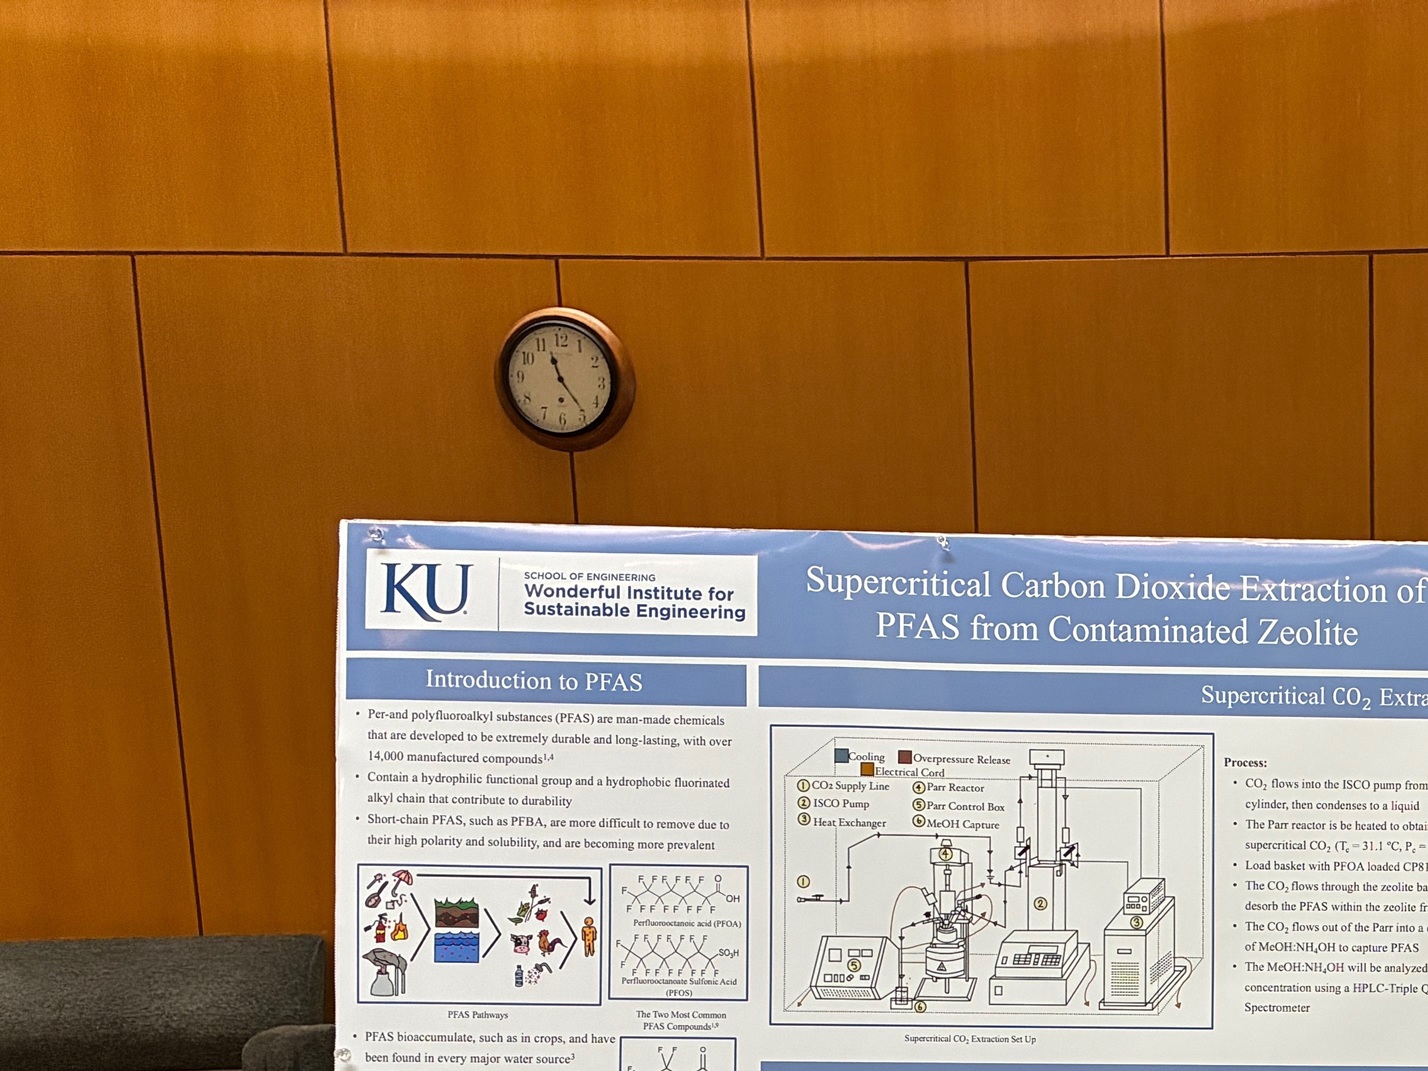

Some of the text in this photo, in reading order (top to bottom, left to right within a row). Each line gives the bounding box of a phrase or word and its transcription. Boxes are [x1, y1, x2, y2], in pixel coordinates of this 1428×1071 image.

[536, 338, 545, 351] 11
[555, 333, 568, 347] 12
[577, 339, 582, 353] 1
[522, 352, 534, 365] 10
[591, 356, 599, 368] 2
[517, 371, 524, 383] 9
[598, 377, 605, 390] 3
[524, 393, 531, 404] 8
[593, 395, 599, 408] 4
[541, 407, 548, 420] 7
[559, 412, 566, 426] 6
[579, 409, 586, 422] 5
[523, 571, 656, 582] SCHOOL OF ENGINEERING
[806, 564, 991, 600] Supercritical
[1001, 570, 1106, 599] Carbon
[1114, 572, 1231, 602] Dioxide
[1238, 574, 1388, 604] Extraction
[380, 563, 474, 622] KU
[523, 582, 734, 601] Wonderful Institute for
[523, 600, 745, 622] Sustainable Engineering
[875, 611, 1358, 646] PFAS from Contaminated Zeolite
[426, 668, 642, 692] Introduction to PFAS
[1201, 684, 1325, 708] Supercritical
[912, 752, 1011, 766] Overpressure Release
[1223, 756, 1267, 767] Process:
[926, 781, 985, 792] Parr Reactor
[813, 797, 870, 811] ISCO Pump
[813, 816, 887, 830] Heat Exchanger
[447, 1009, 508, 1021] PFAS Pathways
[1243, 1001, 1310, 1015] Spectrometer
